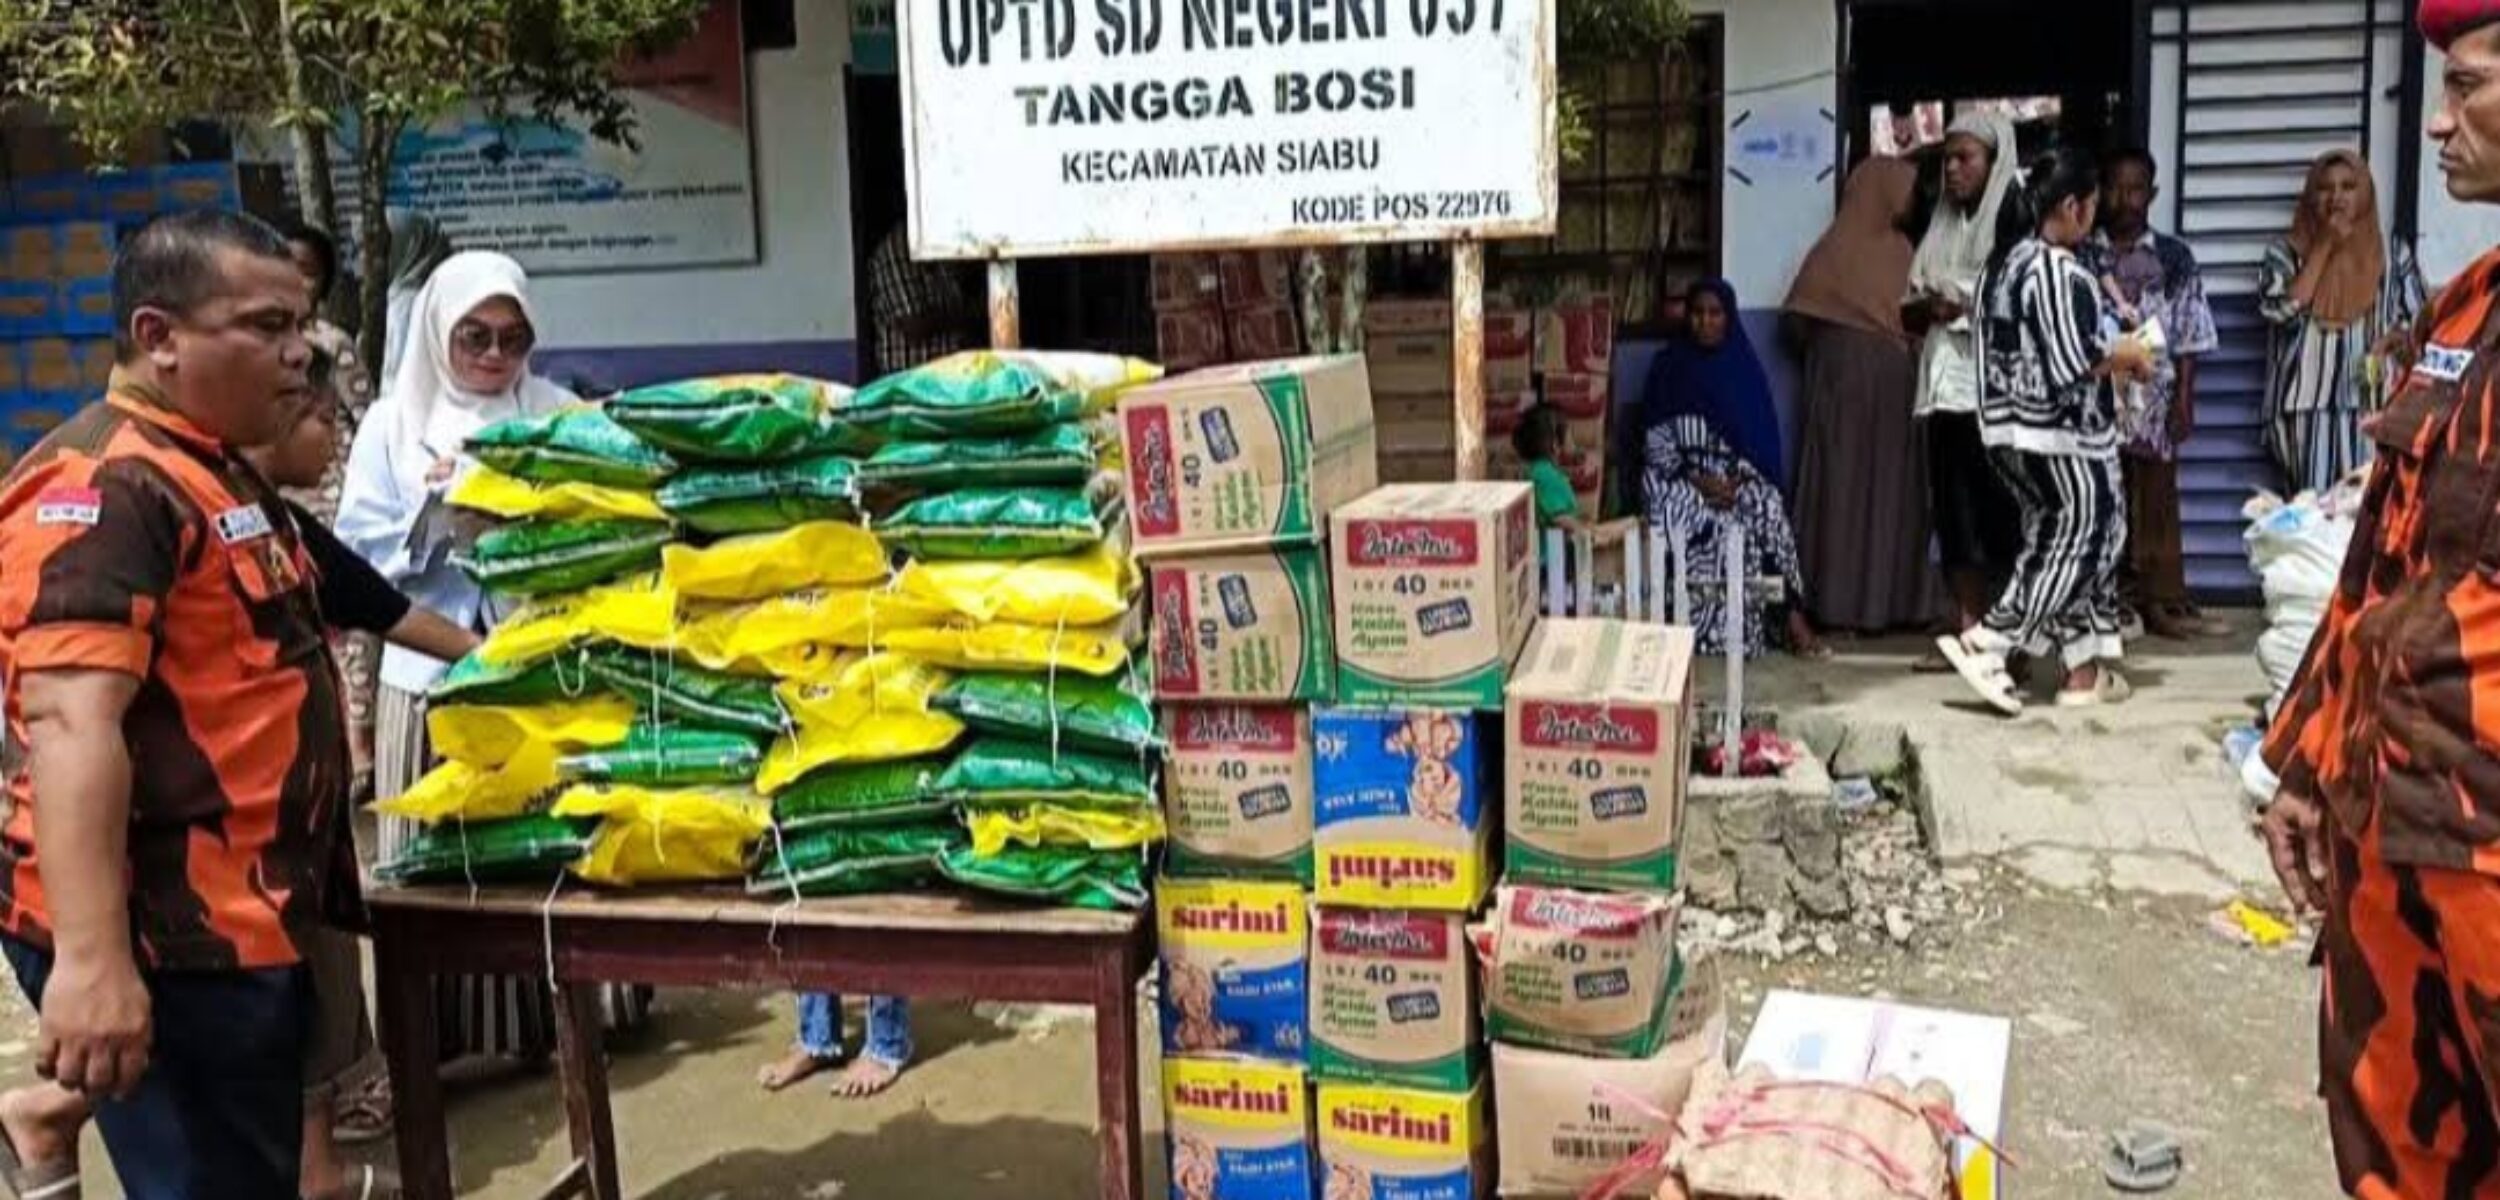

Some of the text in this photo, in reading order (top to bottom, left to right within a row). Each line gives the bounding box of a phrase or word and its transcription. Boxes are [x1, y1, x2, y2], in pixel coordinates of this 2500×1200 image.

[939, 0, 1075, 67] UPTD
[1095, 0, 1162, 55] SD
[1013, 67, 1415, 126] TANGGA BOSI
[1062, 136, 1380, 183] KECAMATAN SIABU
[1293, 194, 1364, 224] KODE
[1373, 190, 1429, 220] POS
[1182, 454, 1201, 487] 40
[1392, 573, 1427, 595] 40
[1199, 618, 1218, 651] 40
[1216, 759, 1248, 781] 40
[1567, 757, 1603, 781] 40
[1330, 855, 1456, 889] sarimi
[1172, 901, 1288, 933] sarimi
[1553, 940, 1587, 963] 40
[1364, 963, 1397, 985] 40
[1174, 1080, 1289, 1114] sarimi
[1332, 1106, 1451, 1145] sarimi
